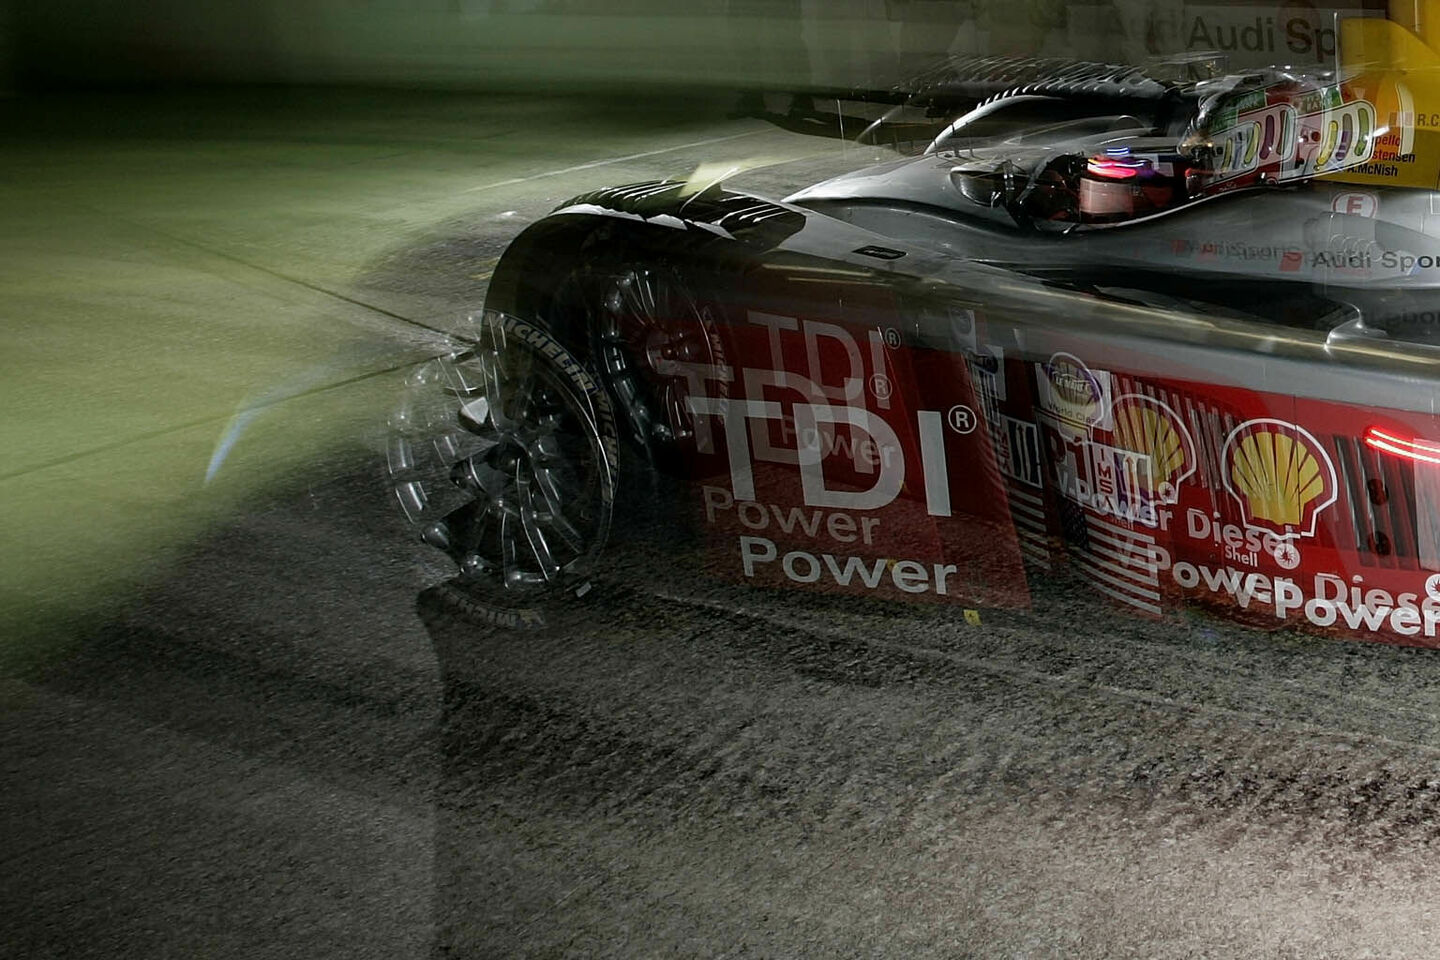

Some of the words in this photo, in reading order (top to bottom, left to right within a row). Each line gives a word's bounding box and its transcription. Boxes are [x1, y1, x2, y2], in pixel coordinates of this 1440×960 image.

[1186, 15, 1276, 52] Audi
[1312, 249, 1372, 269] Audi
[702, 485, 881, 546] Power
[739, 535, 958, 596] Power
[1224, 544, 1258, 568] Shell
